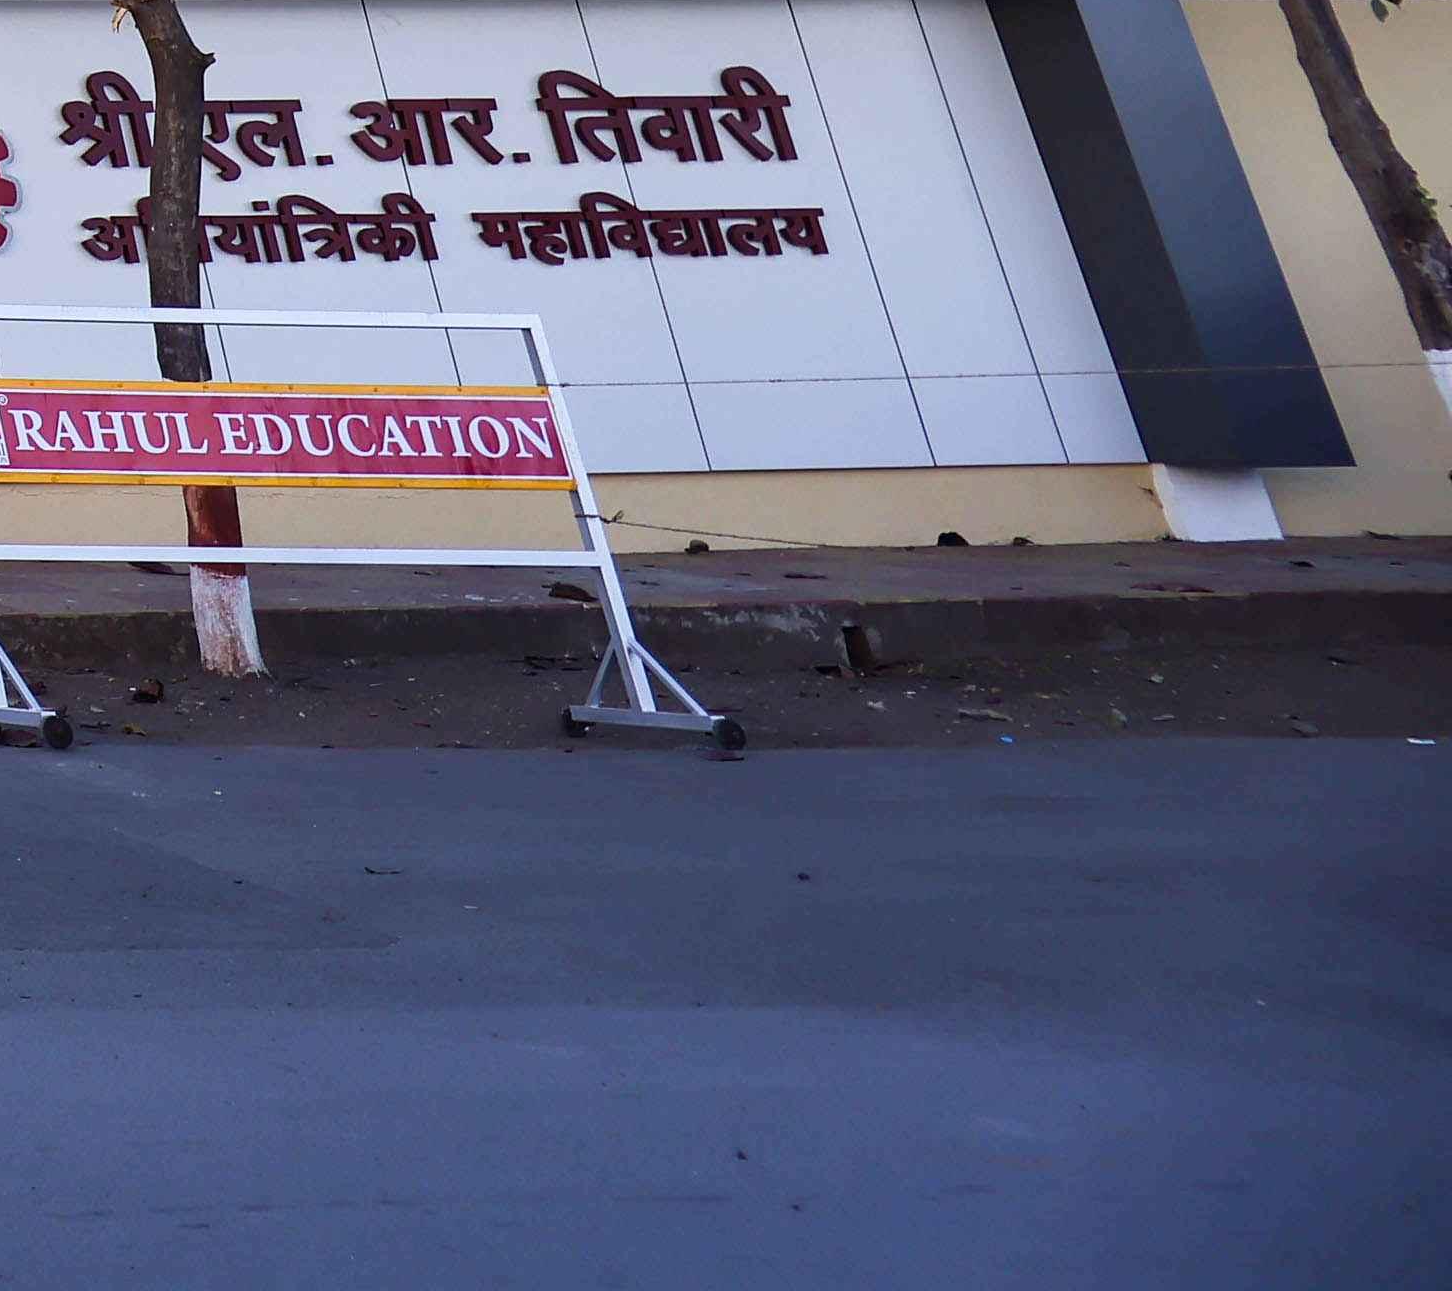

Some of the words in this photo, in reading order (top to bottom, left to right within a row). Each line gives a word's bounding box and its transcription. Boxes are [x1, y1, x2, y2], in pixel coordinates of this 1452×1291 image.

[59, 70, 156, 168] श्री
[349, 98, 531, 166] आर.
[535, 65, 798, 165] तिवारी
[81, 192, 441, 265] अयांत्रिकी
[471, 191, 830, 266] महाविद्यालय
[8, 409, 208, 455] RAHUL
[212, 411, 555, 460] EDUCATION
